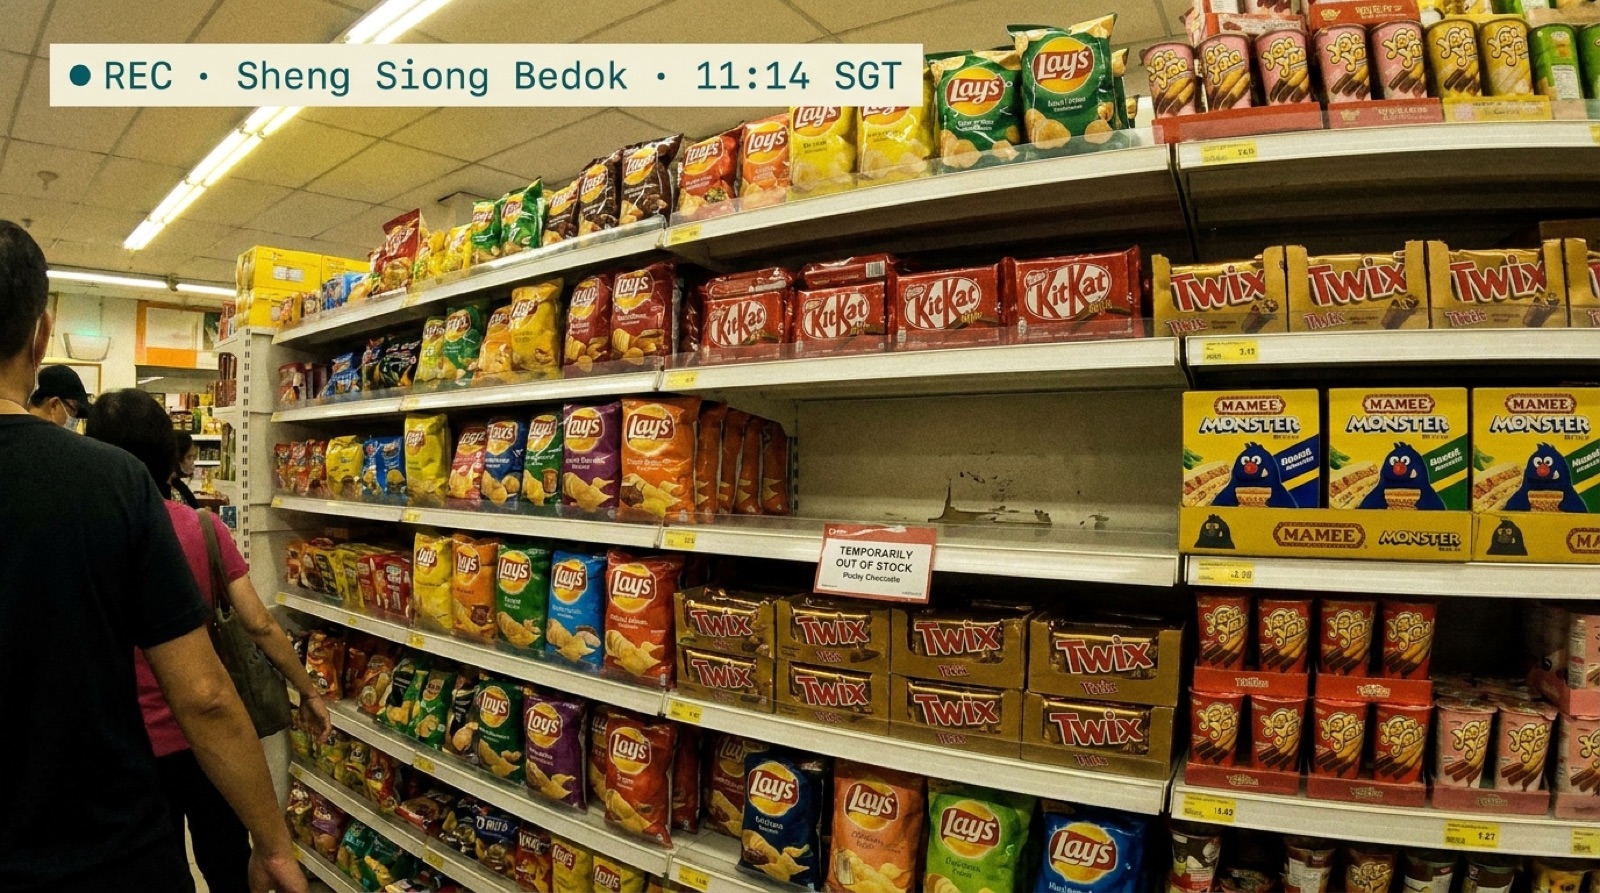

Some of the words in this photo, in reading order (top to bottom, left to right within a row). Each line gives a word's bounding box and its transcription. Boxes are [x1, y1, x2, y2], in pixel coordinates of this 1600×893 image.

[1036, 264, 1106, 320] KitKat
[1170, 265, 1265, 312] Twix
[1308, 256, 1408, 307] Twix
[1450, 254, 1546, 302] Twix
[811, 294, 866, 338] KitKat
[914, 278, 976, 329] KitKat
[717, 302, 763, 345] KitKat
[1222, 399, 1279, 412] MAMEE
[1370, 398, 1429, 411] MAMEE
[1512, 398, 1569, 411] MAMEE
[1199, 416, 1301, 434] MONSTER
[1345, 415, 1450, 434] MONSTER
[1489, 415, 1591, 435] MONSTER
[1284, 528, 1356, 543] MAMEE
[1379, 530, 1462, 546] MONSTER
[836, 558, 858, 569] OUT
[859, 560, 875, 570] OF
[876, 561, 914, 573] STOCK
[840, 545, 914, 560] TEMPORARILY
[691, 608, 753, 637] Twix
[795, 612, 870, 645] Twix
[914, 619, 1001, 656] Twix
[1056, 635, 1154, 674] Twix
[692, 658, 754, 688] Twix
[795, 674, 870, 706] Twix
[913, 692, 1000, 726] Twix
[1050, 708, 1144, 746] Twix
